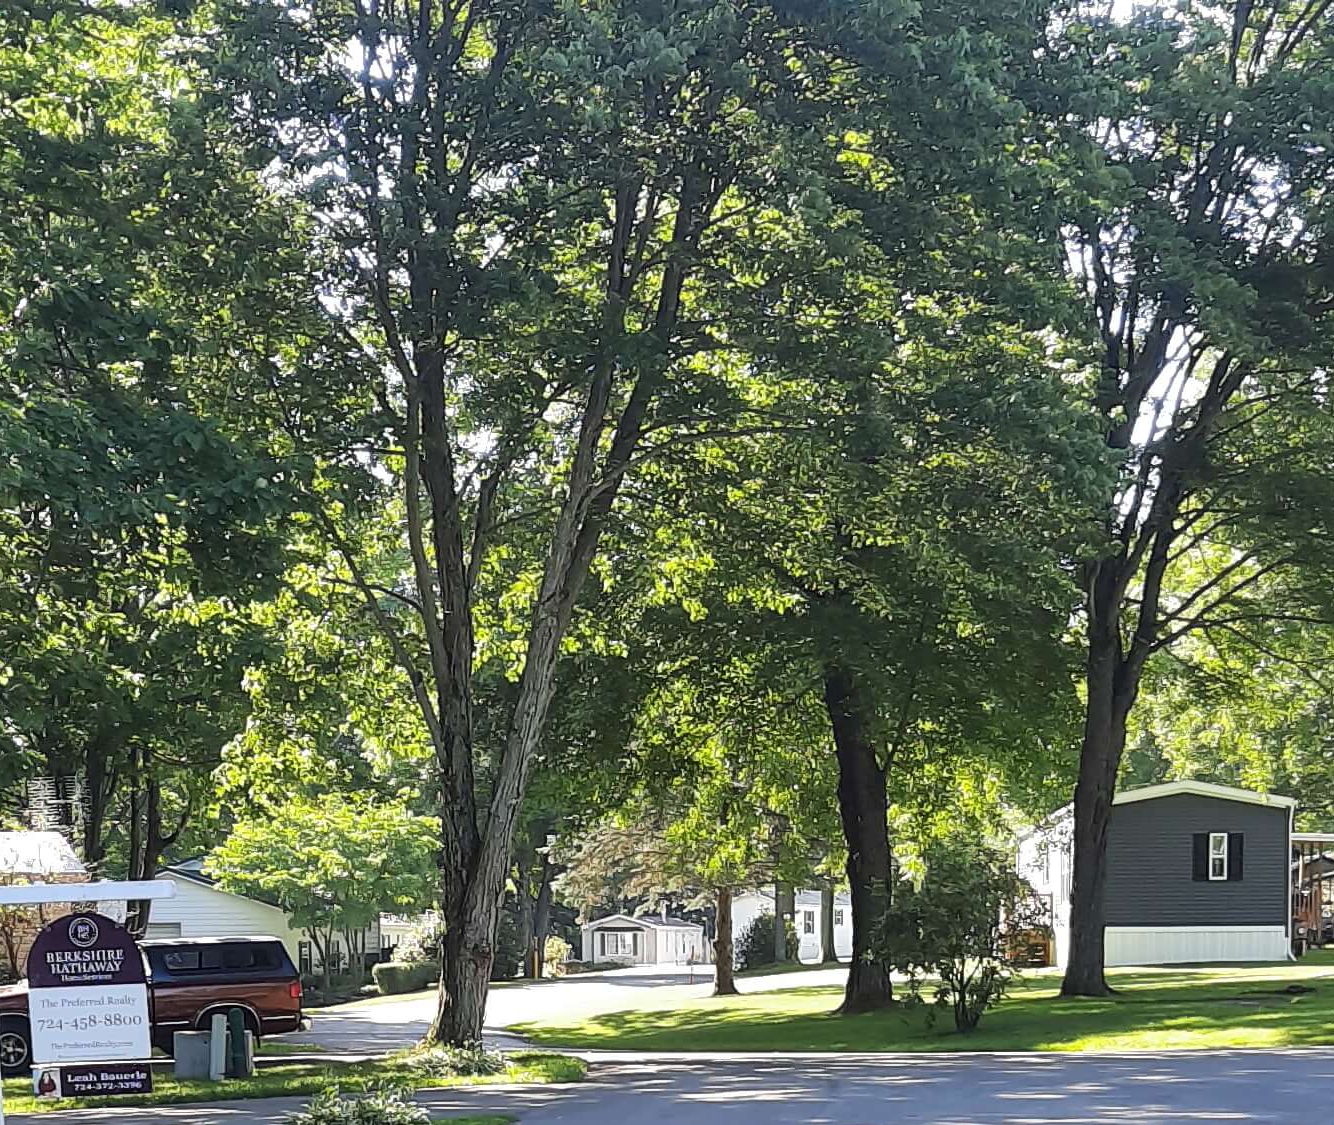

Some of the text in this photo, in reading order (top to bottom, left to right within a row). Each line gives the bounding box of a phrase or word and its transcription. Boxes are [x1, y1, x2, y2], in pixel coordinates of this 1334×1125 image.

[46, 949, 124, 963] BERKSHIRE
[51, 961, 122, 974] HATHAWAY
[41, 992, 137, 1008] The Preferred Realty
[37, 1012, 142, 1032] 724-458-8800
[67, 1070, 147, 1083] Leah Bauerle
